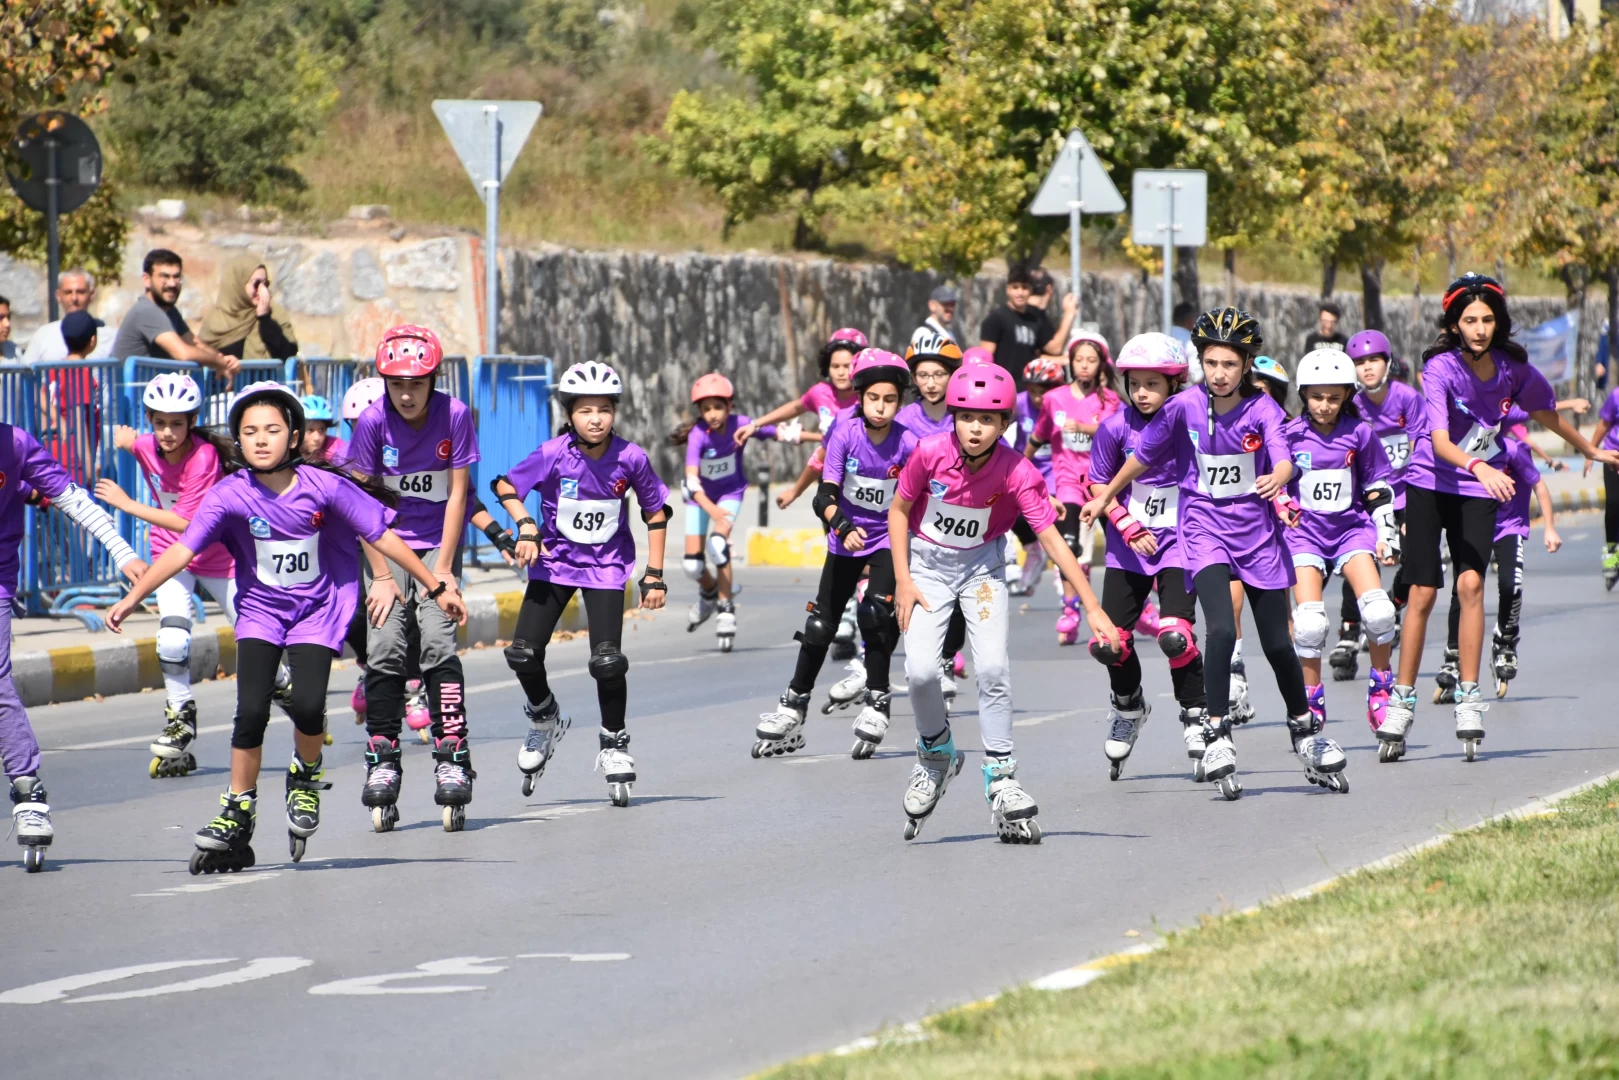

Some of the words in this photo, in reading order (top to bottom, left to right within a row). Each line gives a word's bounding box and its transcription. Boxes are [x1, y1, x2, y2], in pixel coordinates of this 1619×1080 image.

[708, 462, 728, 475] 733
[1207, 466, 1241, 486] 723
[399, 474, 433, 493] 668
[1313, 482, 1342, 501] 657
[856, 487, 884, 505] 650
[1145, 496, 1167, 517] 651
[572, 512, 605, 531] 639
[933, 512, 980, 538] 2960
[272, 552, 309, 574] 730
[440, 682, 462, 713] FUN
